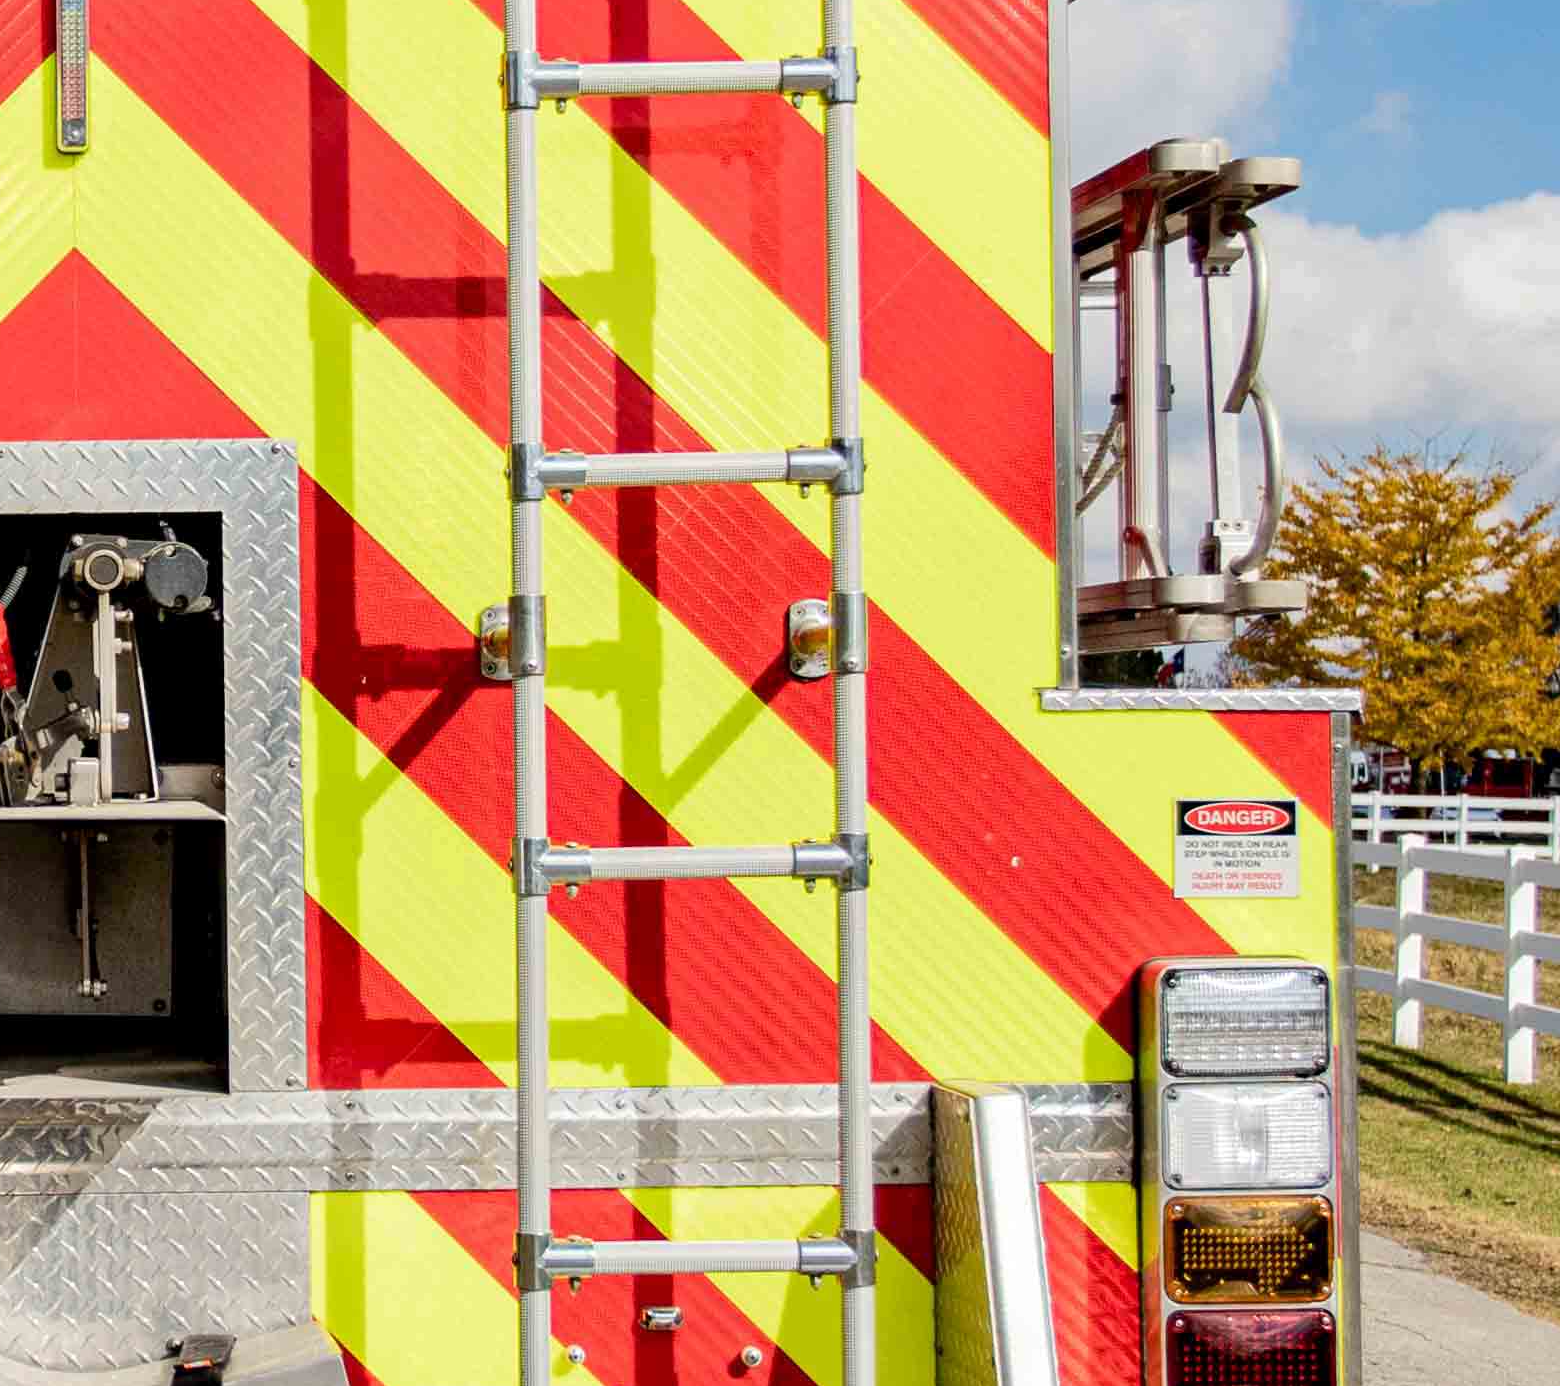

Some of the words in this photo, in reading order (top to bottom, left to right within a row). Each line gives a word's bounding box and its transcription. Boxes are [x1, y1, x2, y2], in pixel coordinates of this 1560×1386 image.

[1197, 810, 1276, 825] DANGER
[1185, 840, 1199, 848] DO
[1201, 840, 1219, 848] NOT
[1246, 840, 1260, 848] ON
[1225, 860, 1261, 868] MOTION
